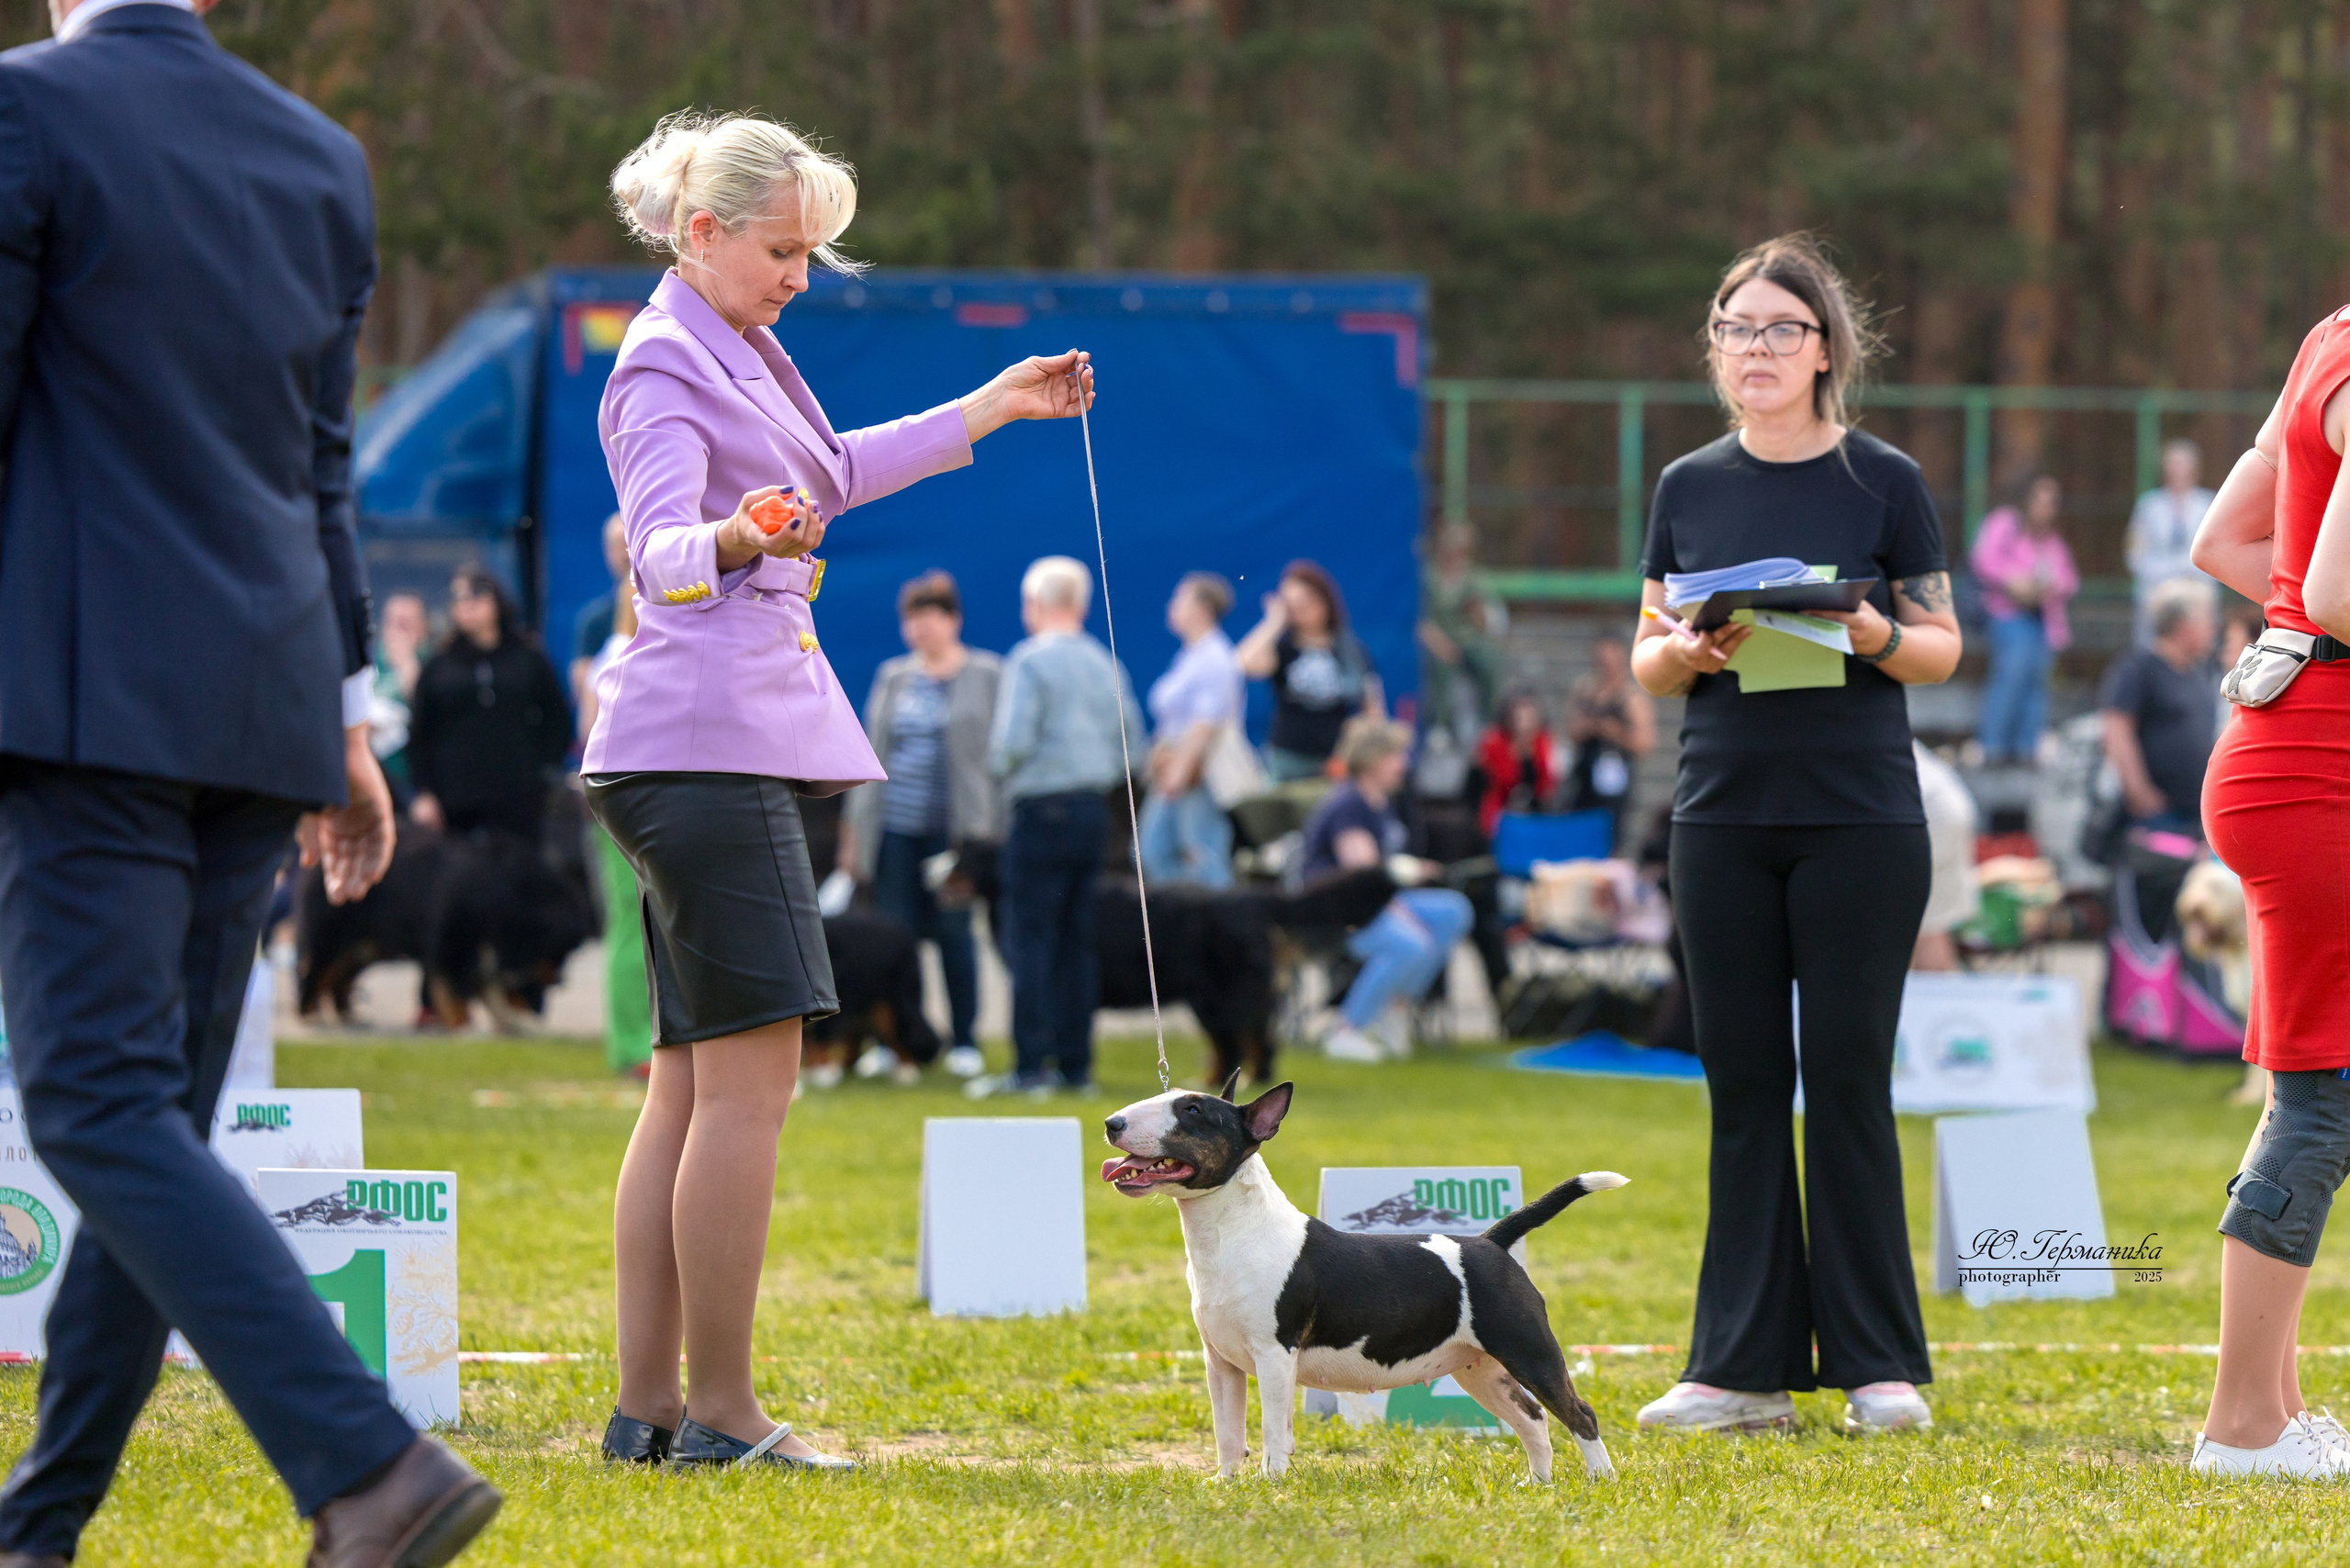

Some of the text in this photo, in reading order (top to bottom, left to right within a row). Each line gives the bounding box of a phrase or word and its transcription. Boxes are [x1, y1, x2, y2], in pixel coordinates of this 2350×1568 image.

[346, 1179, 447, 1222] РФОС
[1415, 1178, 1511, 1220] РФОС
[307, 1249, 386, 1383] 1
